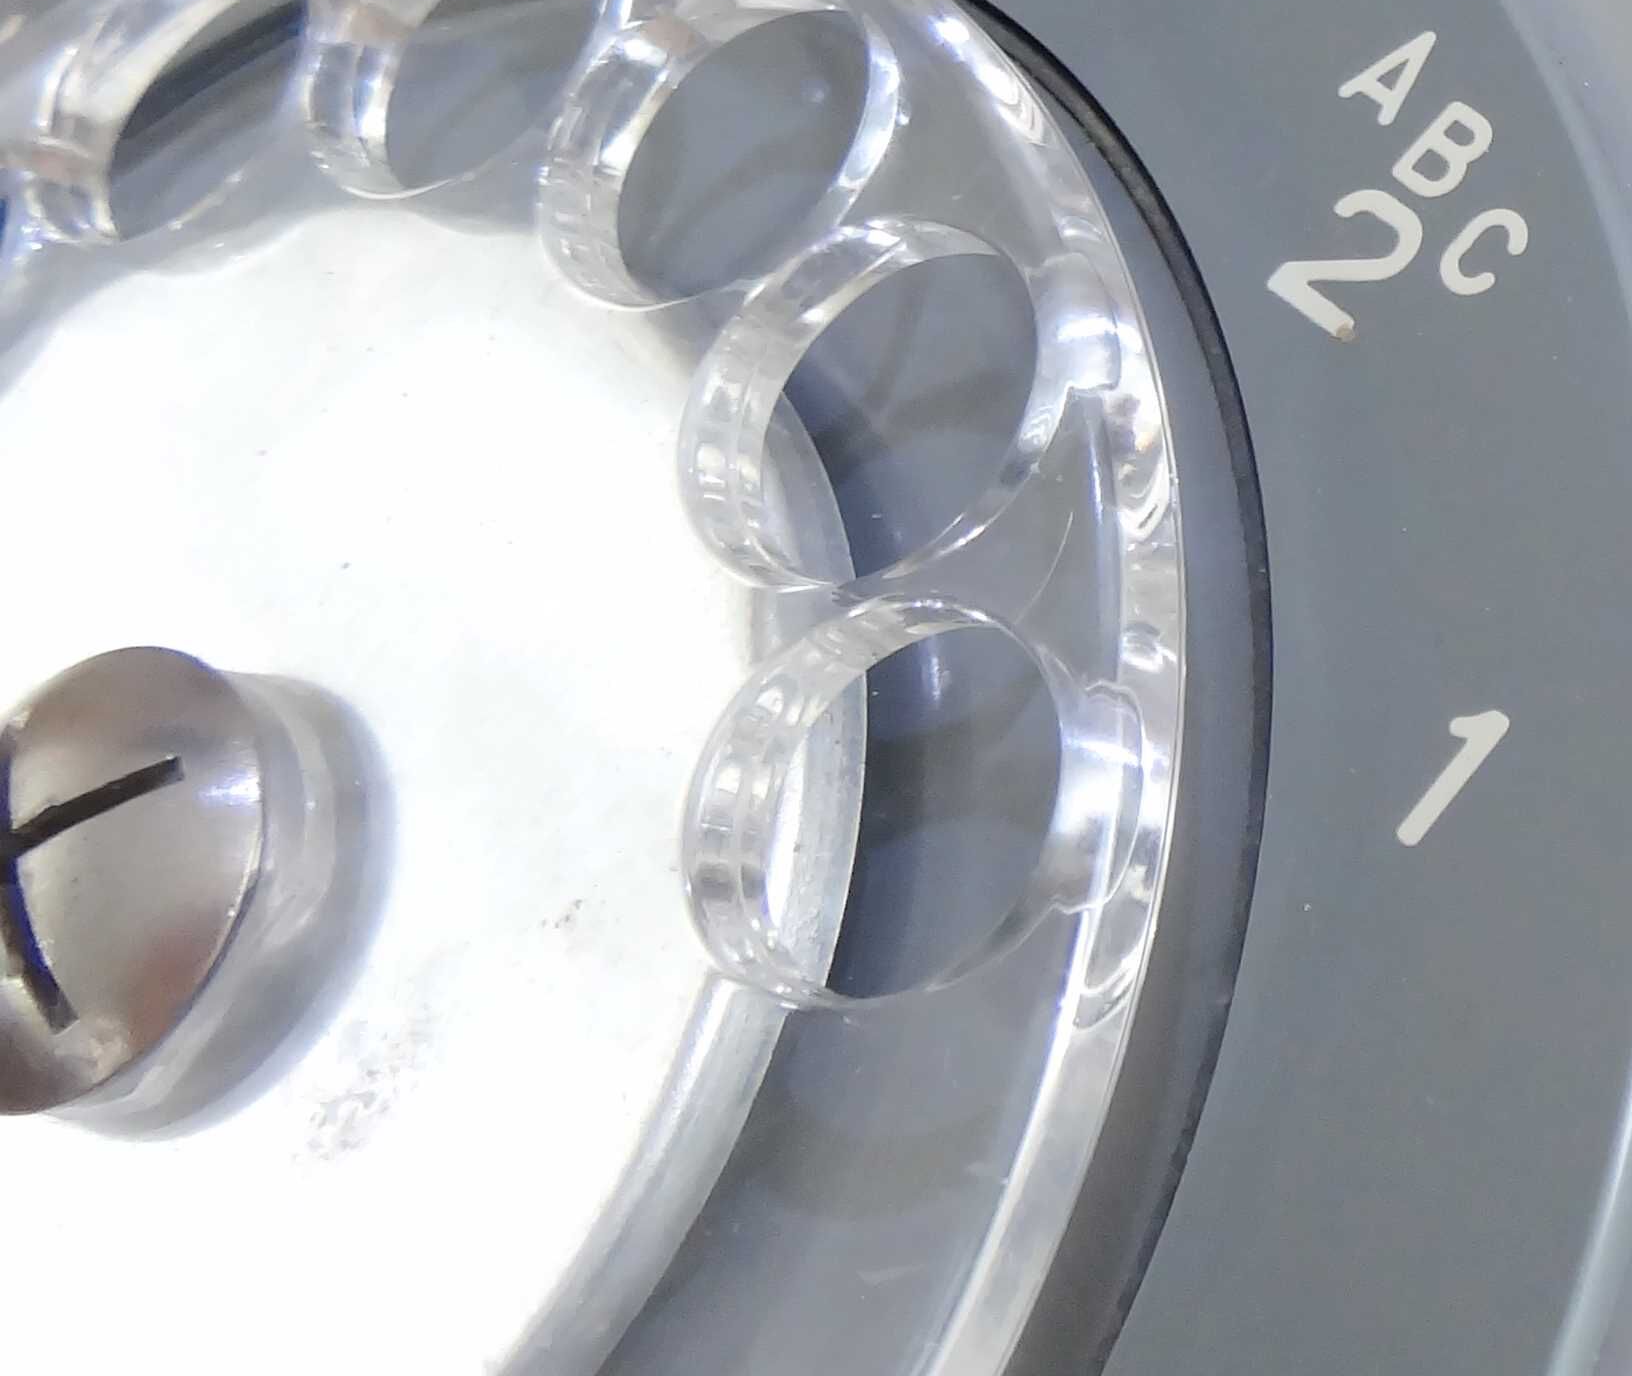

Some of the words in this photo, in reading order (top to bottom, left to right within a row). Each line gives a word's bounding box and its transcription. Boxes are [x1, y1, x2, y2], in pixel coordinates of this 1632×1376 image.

[1337, 30, 1529, 296] ABC
[1266, 188, 1423, 341] 2
[1396, 709, 1511, 848] 1
